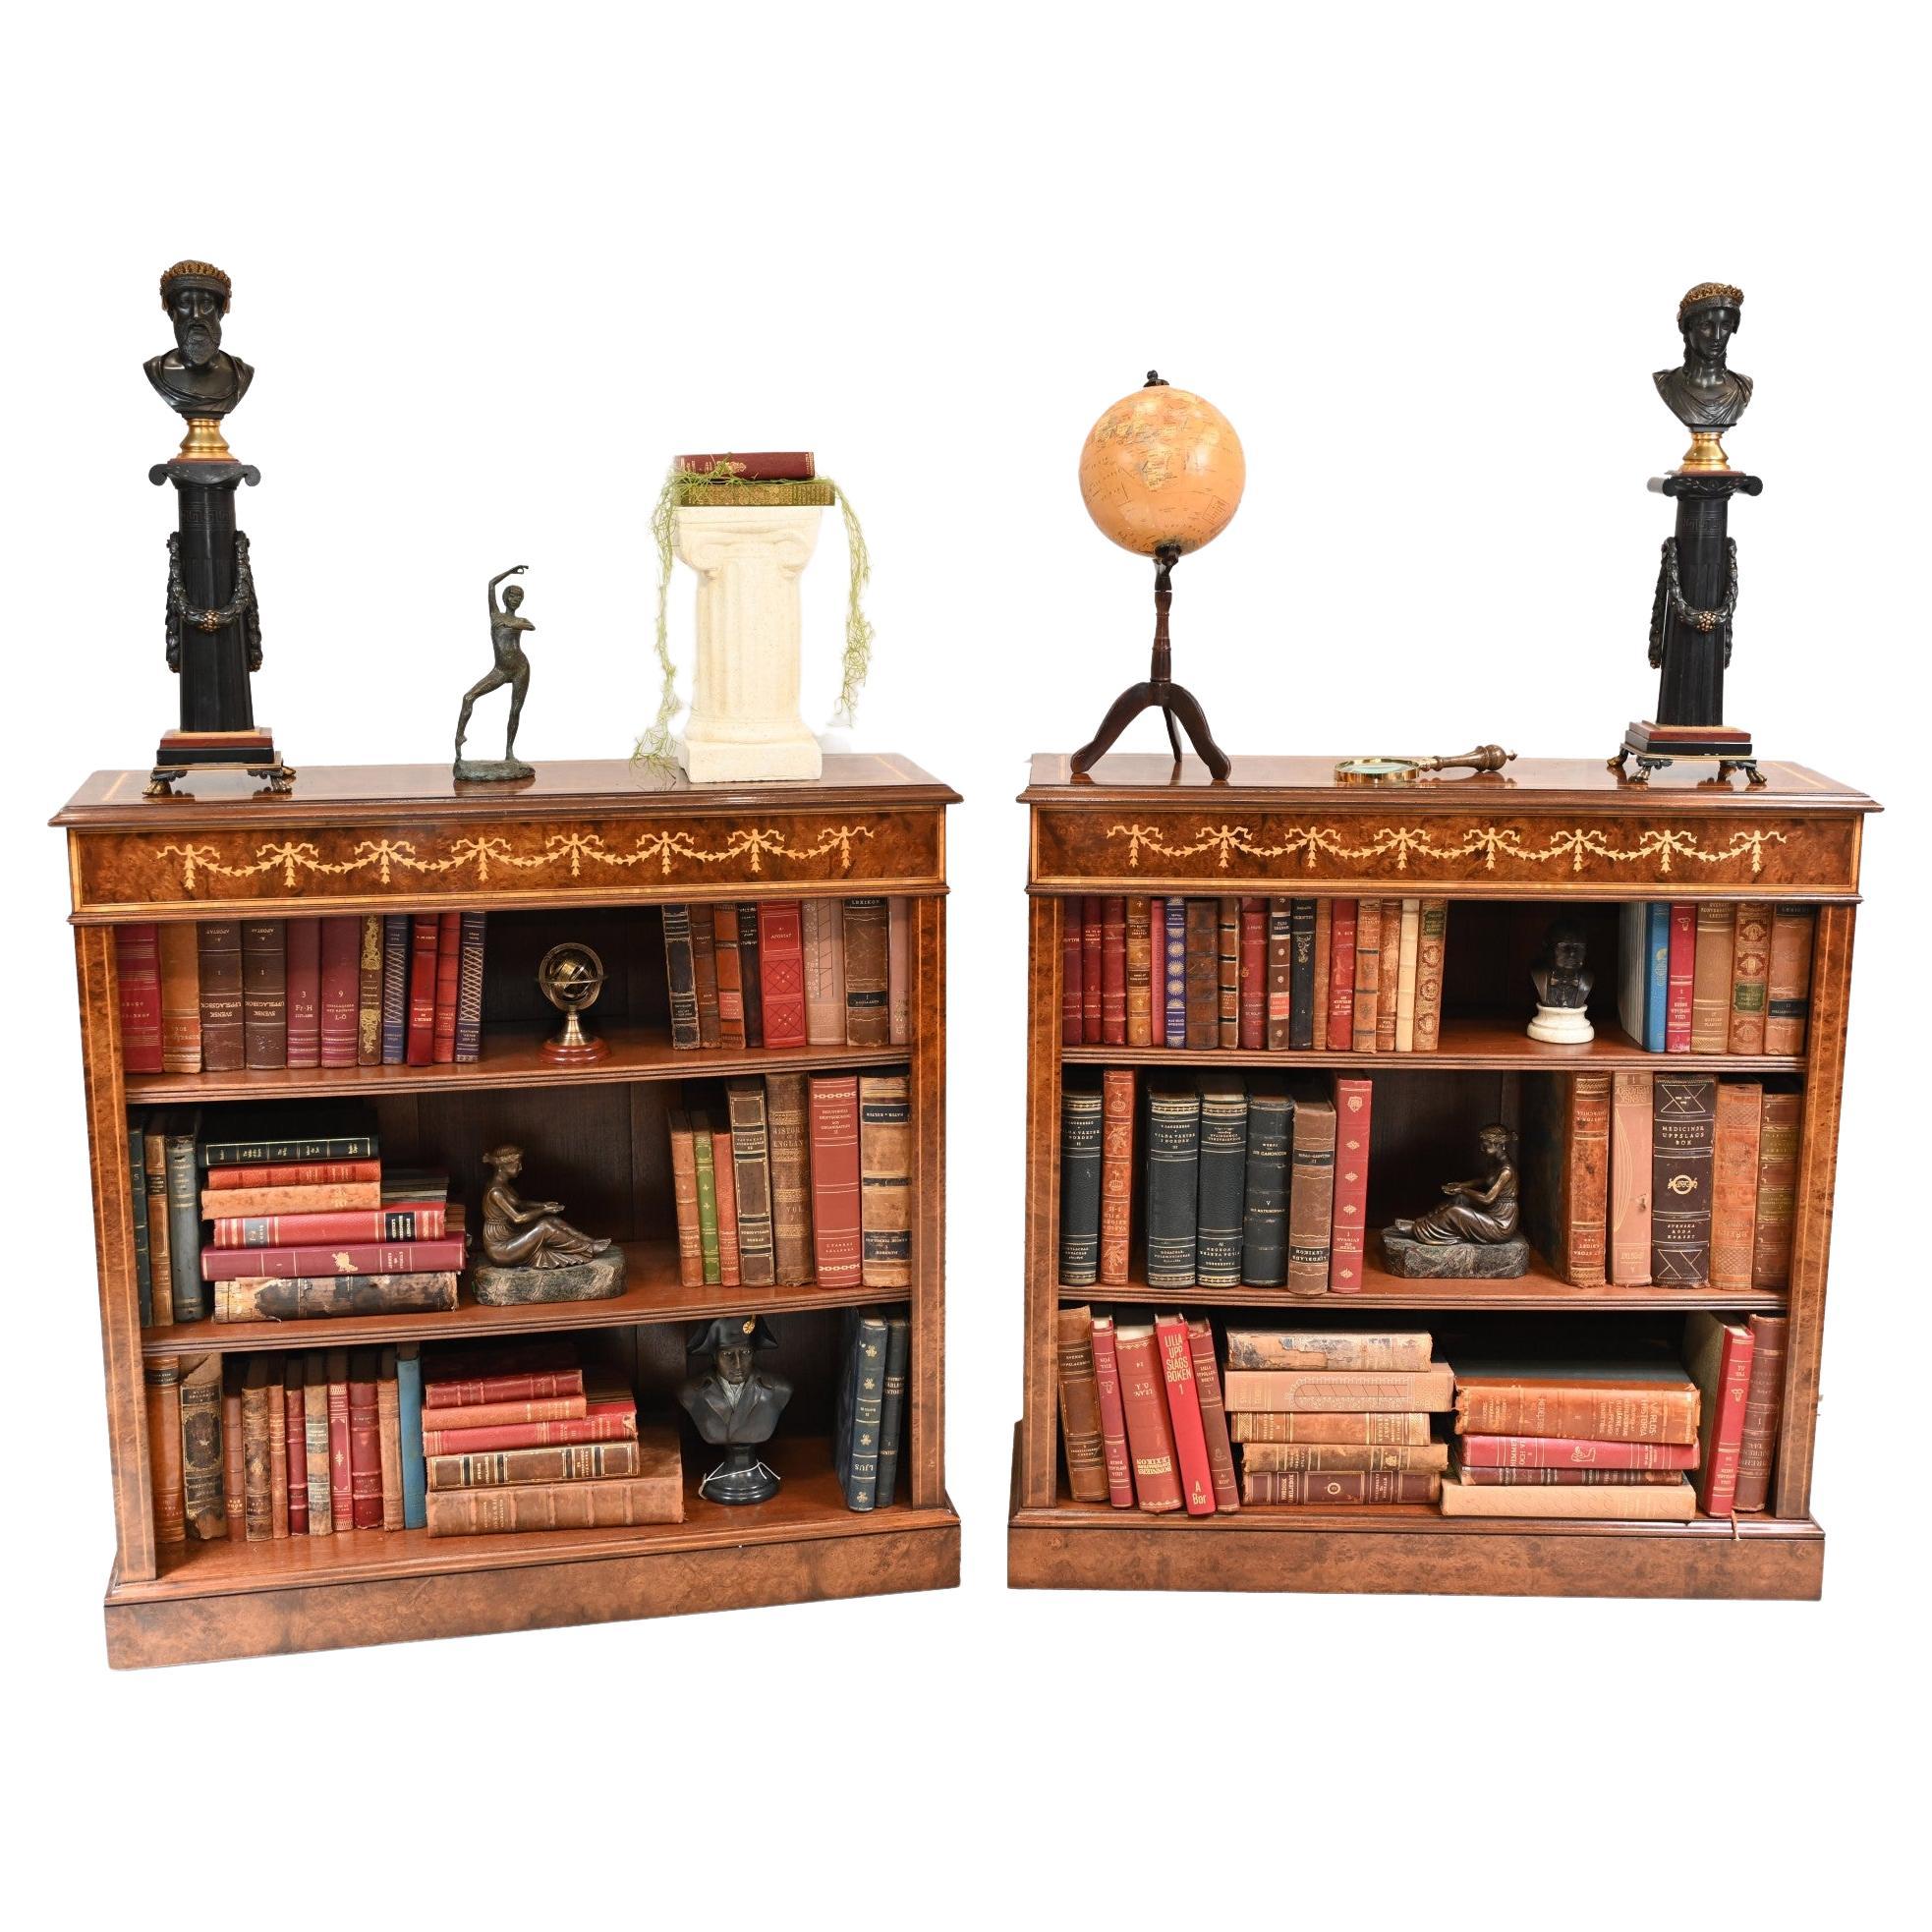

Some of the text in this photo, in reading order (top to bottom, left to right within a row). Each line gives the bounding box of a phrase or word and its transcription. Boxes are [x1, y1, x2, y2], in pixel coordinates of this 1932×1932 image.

[1164, 1335, 1183, 1347] LILLA
[1168, 1345, 1183, 1358] UPP
[1165, 1356, 1189, 1371] SLAGS
[1166, 1368, 1192, 1383] BOKEN
[1178, 1384, 1184, 1394] 1
[1640, 1399, 1649, 1437] HISTORIA
[854, 1463, 875, 1472] LJUS
[1195, 1480, 1202, 1492] A
[1192, 1493, 1207, 1505] Bor
